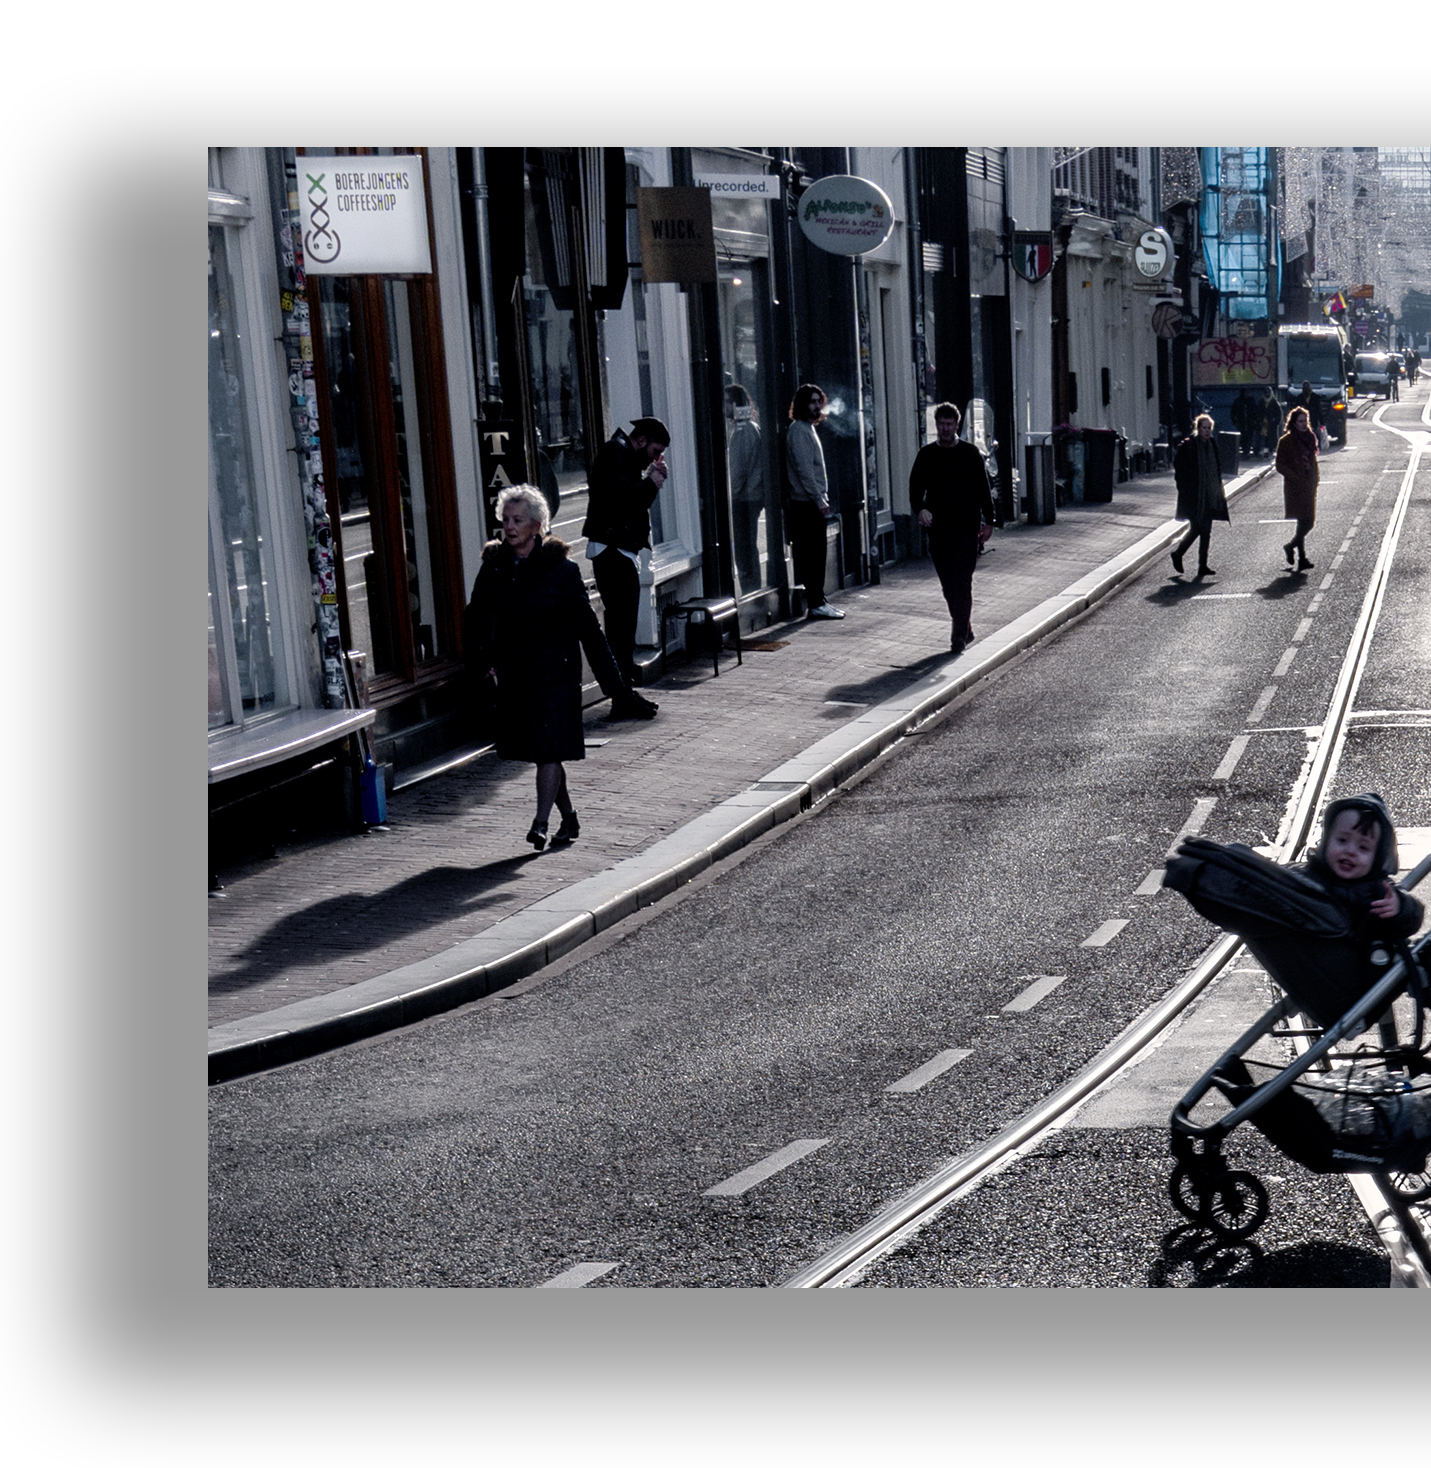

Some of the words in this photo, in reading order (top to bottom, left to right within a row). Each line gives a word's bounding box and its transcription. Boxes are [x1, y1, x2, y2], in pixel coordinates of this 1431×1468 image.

[335, 172, 409, 190] BOEREJONGENS
[337, 194, 396, 211] COFFEESHOP
[826, 226, 879, 237] RESTAURANT
[859, 220, 885, 229] GRILL
